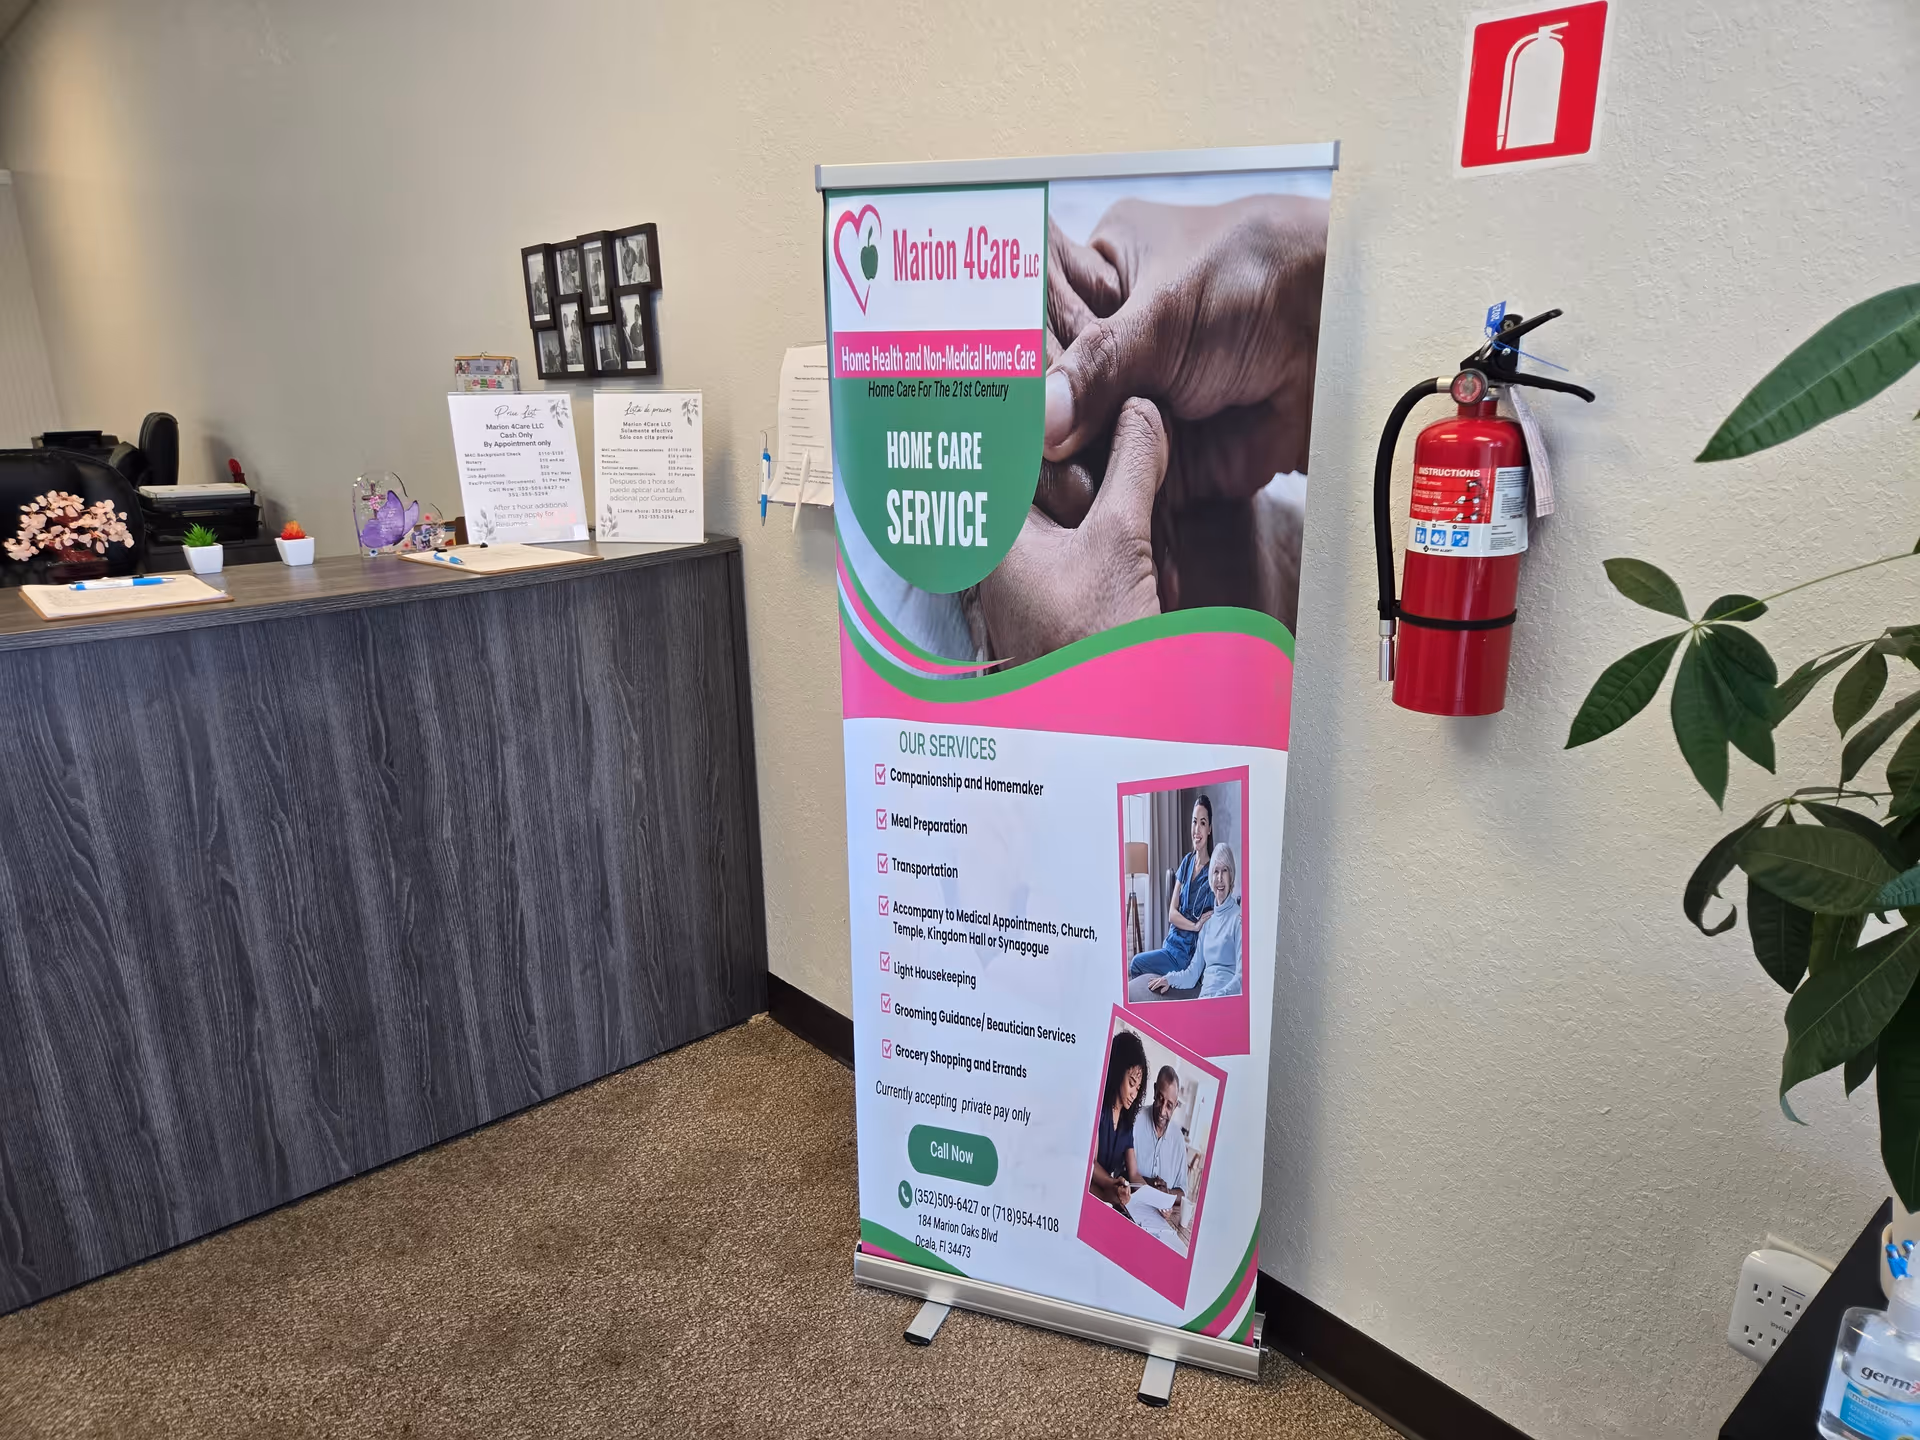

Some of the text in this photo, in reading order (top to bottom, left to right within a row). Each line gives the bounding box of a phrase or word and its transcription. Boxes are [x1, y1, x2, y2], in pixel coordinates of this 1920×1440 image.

[893, 225, 1039, 281] Marion 4Care LLC
[842, 344, 1036, 371] Home Health and Non-Medical Home Care
[869, 381, 1008, 401] Home Care For The 21st Century
[494, 405, 540, 420] Price List
[624, 401, 641, 416] Lista
[644, 404, 650, 412] de
[887, 431, 982, 469] HOME CARE
[1419, 467, 1480, 477] INSTRUCTIONS
[524, 511, 543, 519] apply
[535, 501, 568, 509] additional
[887, 489, 987, 547] SERVICE
[900, 731, 996, 761] OUR SERVICES
[890, 768, 1043, 796] Companionship and Homemaker
[891, 813, 967, 836] Meal Preparation
[892, 858, 958, 879] Transportation
[893, 901, 1098, 942] Accompany to Medical Appointments, Church,
[893, 922, 1049, 957] Temple, Kingdom Hall or Synagogue
[894, 962, 976, 990] Light Housekeeping
[895, 1003, 1076, 1044] Grooming Guidance/ Beautician Services
[896, 1045, 1027, 1078] Grocery Shopping and Errands
[876, 1081, 1031, 1126] Currently accepting private pay only
[930, 1141, 973, 1164] Call Now
[914, 1188, 1059, 1232] (352)509-6427 or (718)954-4108
[918, 1214, 998, 1243] 184 Marion Oaks Blvd
[915, 1235, 938, 1252] Ocala,
[948, 1241, 971, 1258] 34473
